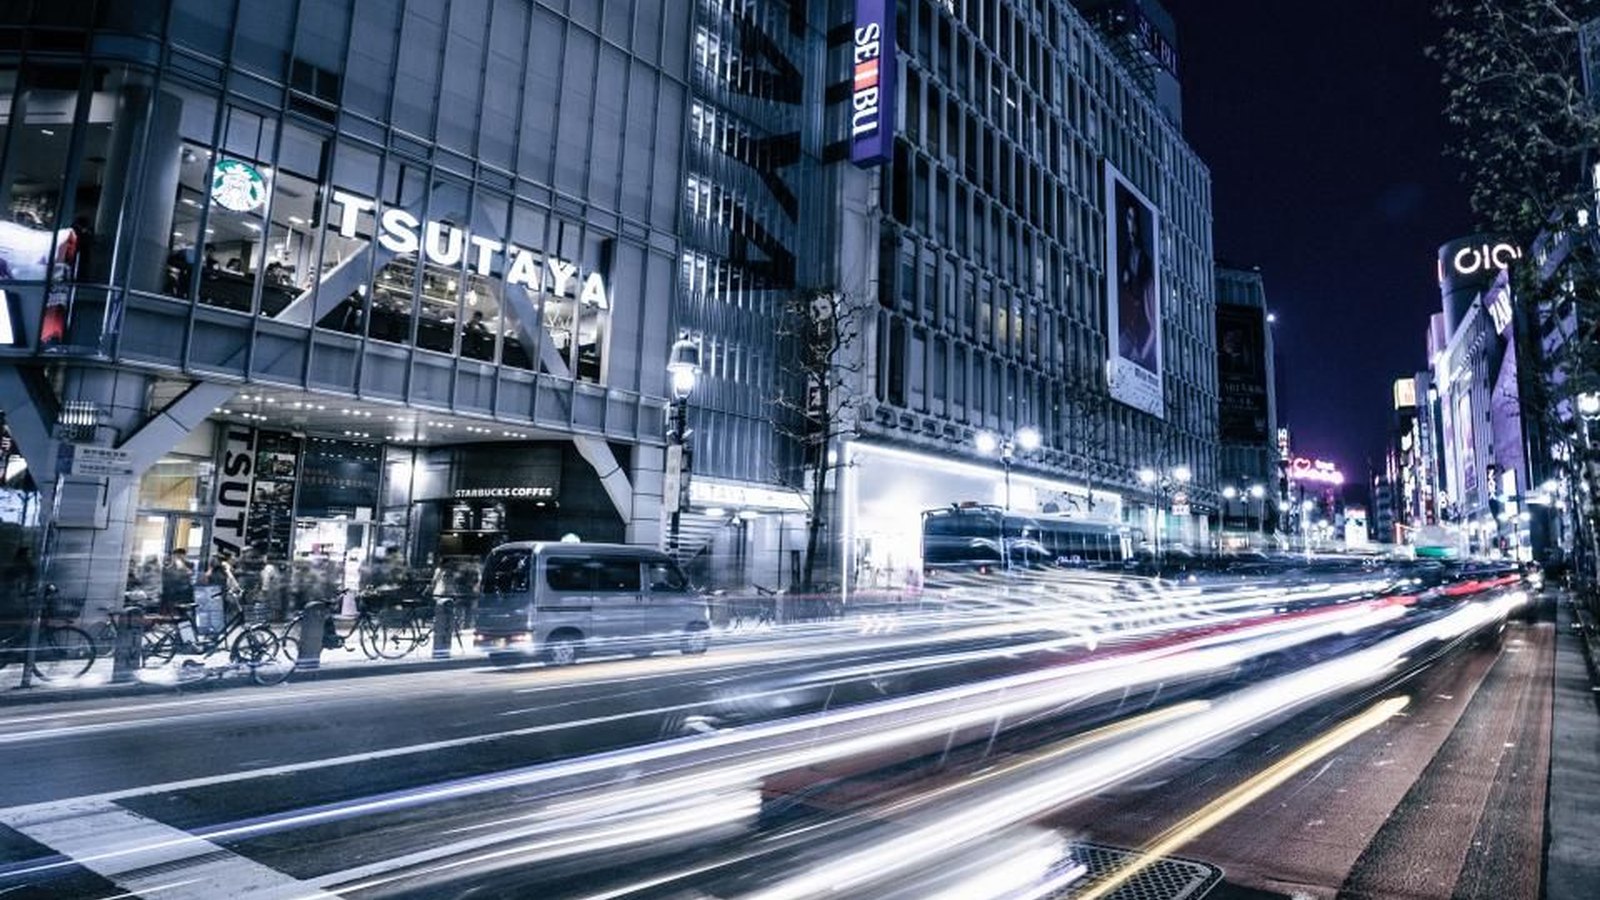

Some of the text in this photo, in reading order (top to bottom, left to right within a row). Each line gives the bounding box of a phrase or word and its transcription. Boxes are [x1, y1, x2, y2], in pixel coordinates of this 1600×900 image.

[853, 22, 880, 137] SEIBU
[333, 190, 609, 310] TSUTAYA
[455, 487, 553, 498] STARBUCKS COFFEE
